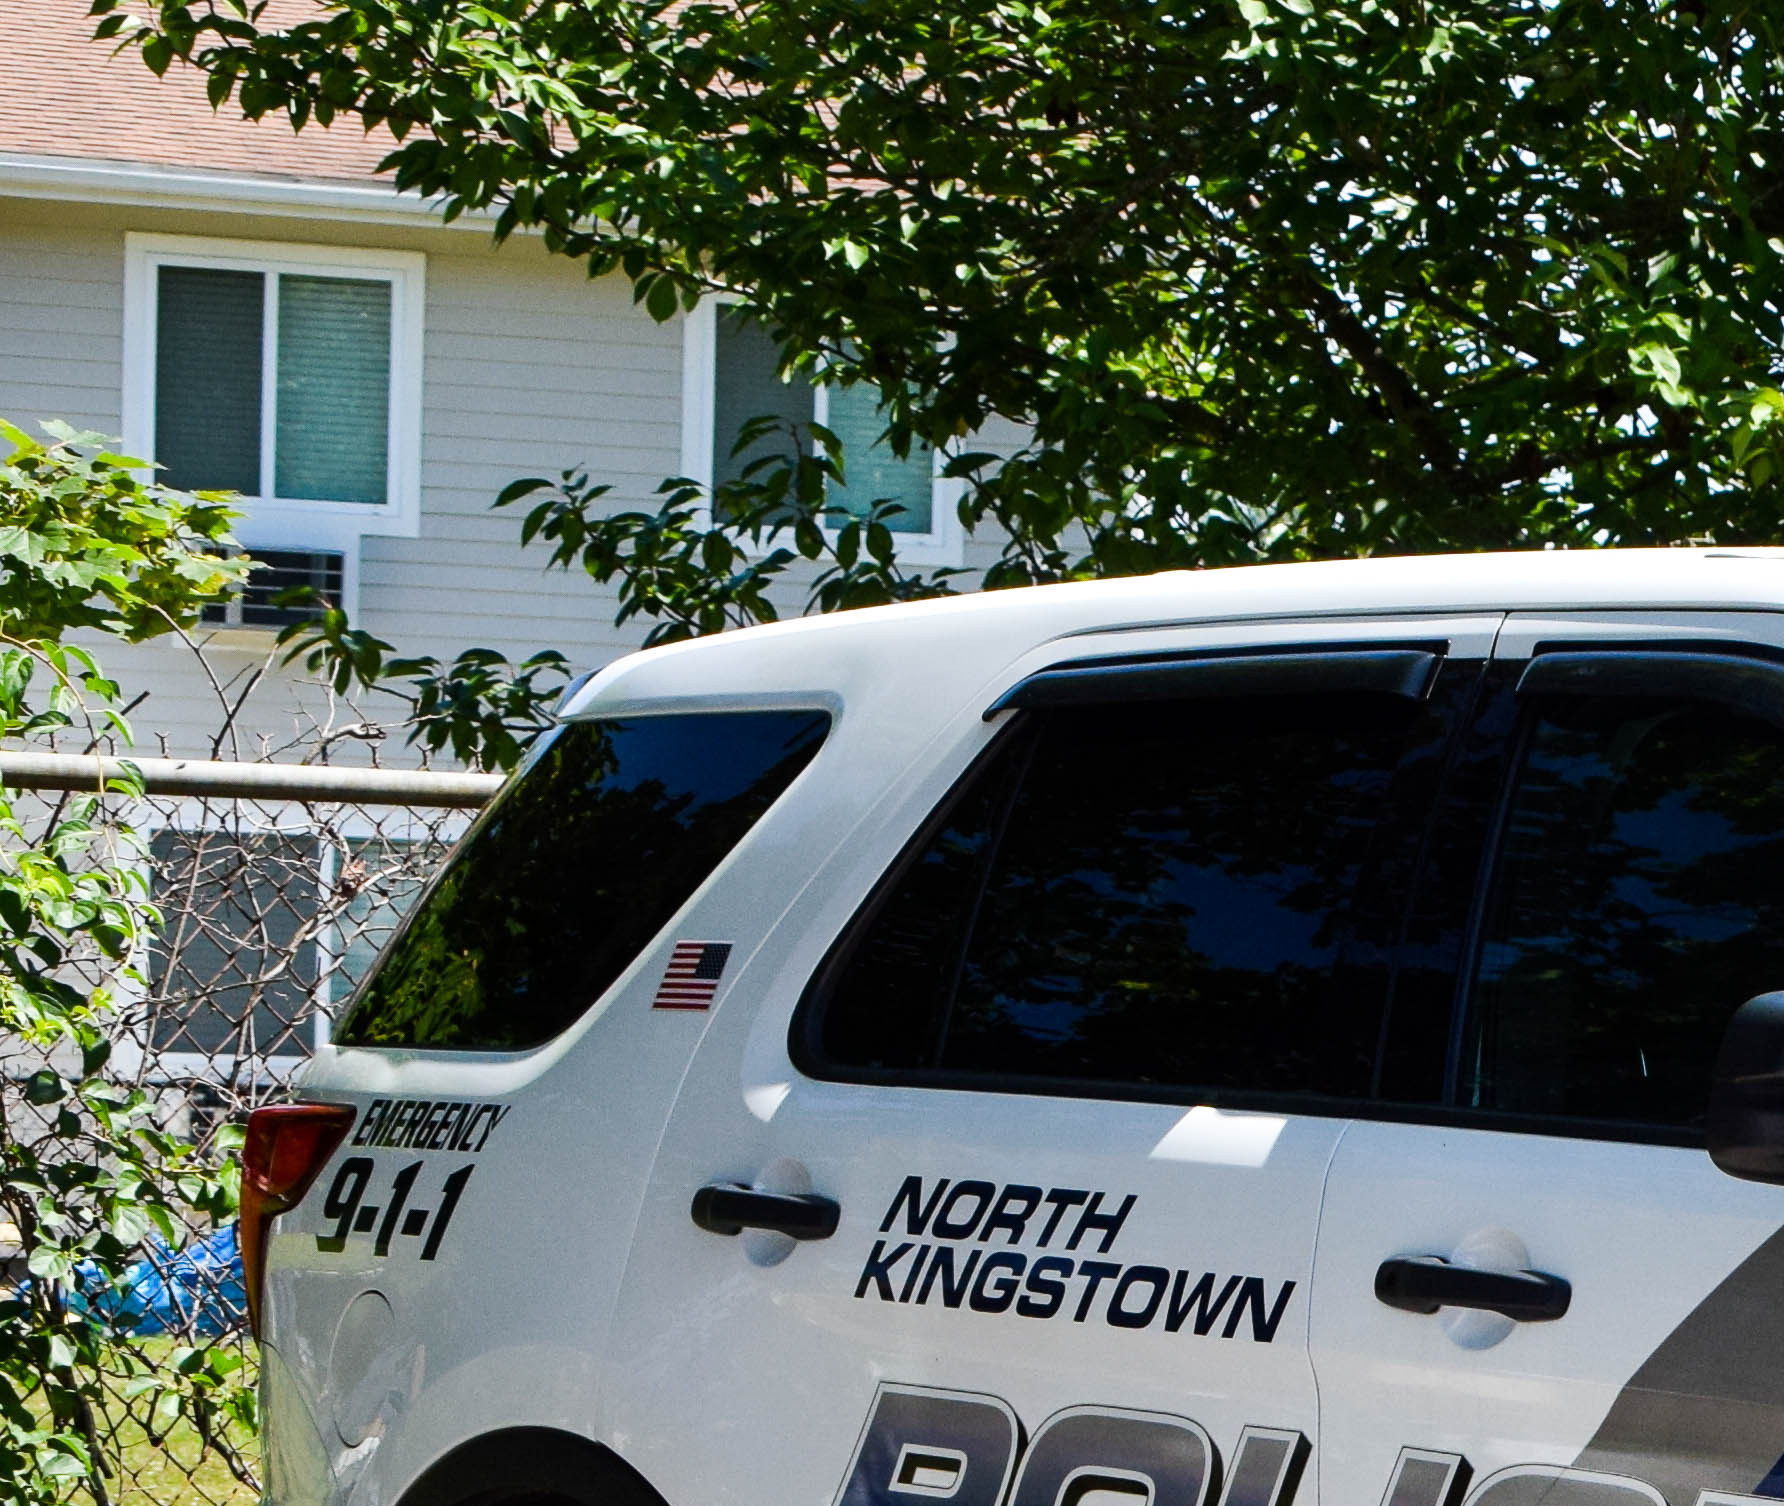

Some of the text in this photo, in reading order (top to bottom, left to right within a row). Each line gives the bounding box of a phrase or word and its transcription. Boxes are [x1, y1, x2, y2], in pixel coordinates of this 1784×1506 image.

[351, 1099, 511, 1153] EMERGENCY
[316, 1157, 475, 1261] 9-1-1
[879, 1175, 1138, 1254] NORTH
[854, 1240, 1297, 1343] KINGSTOWN
